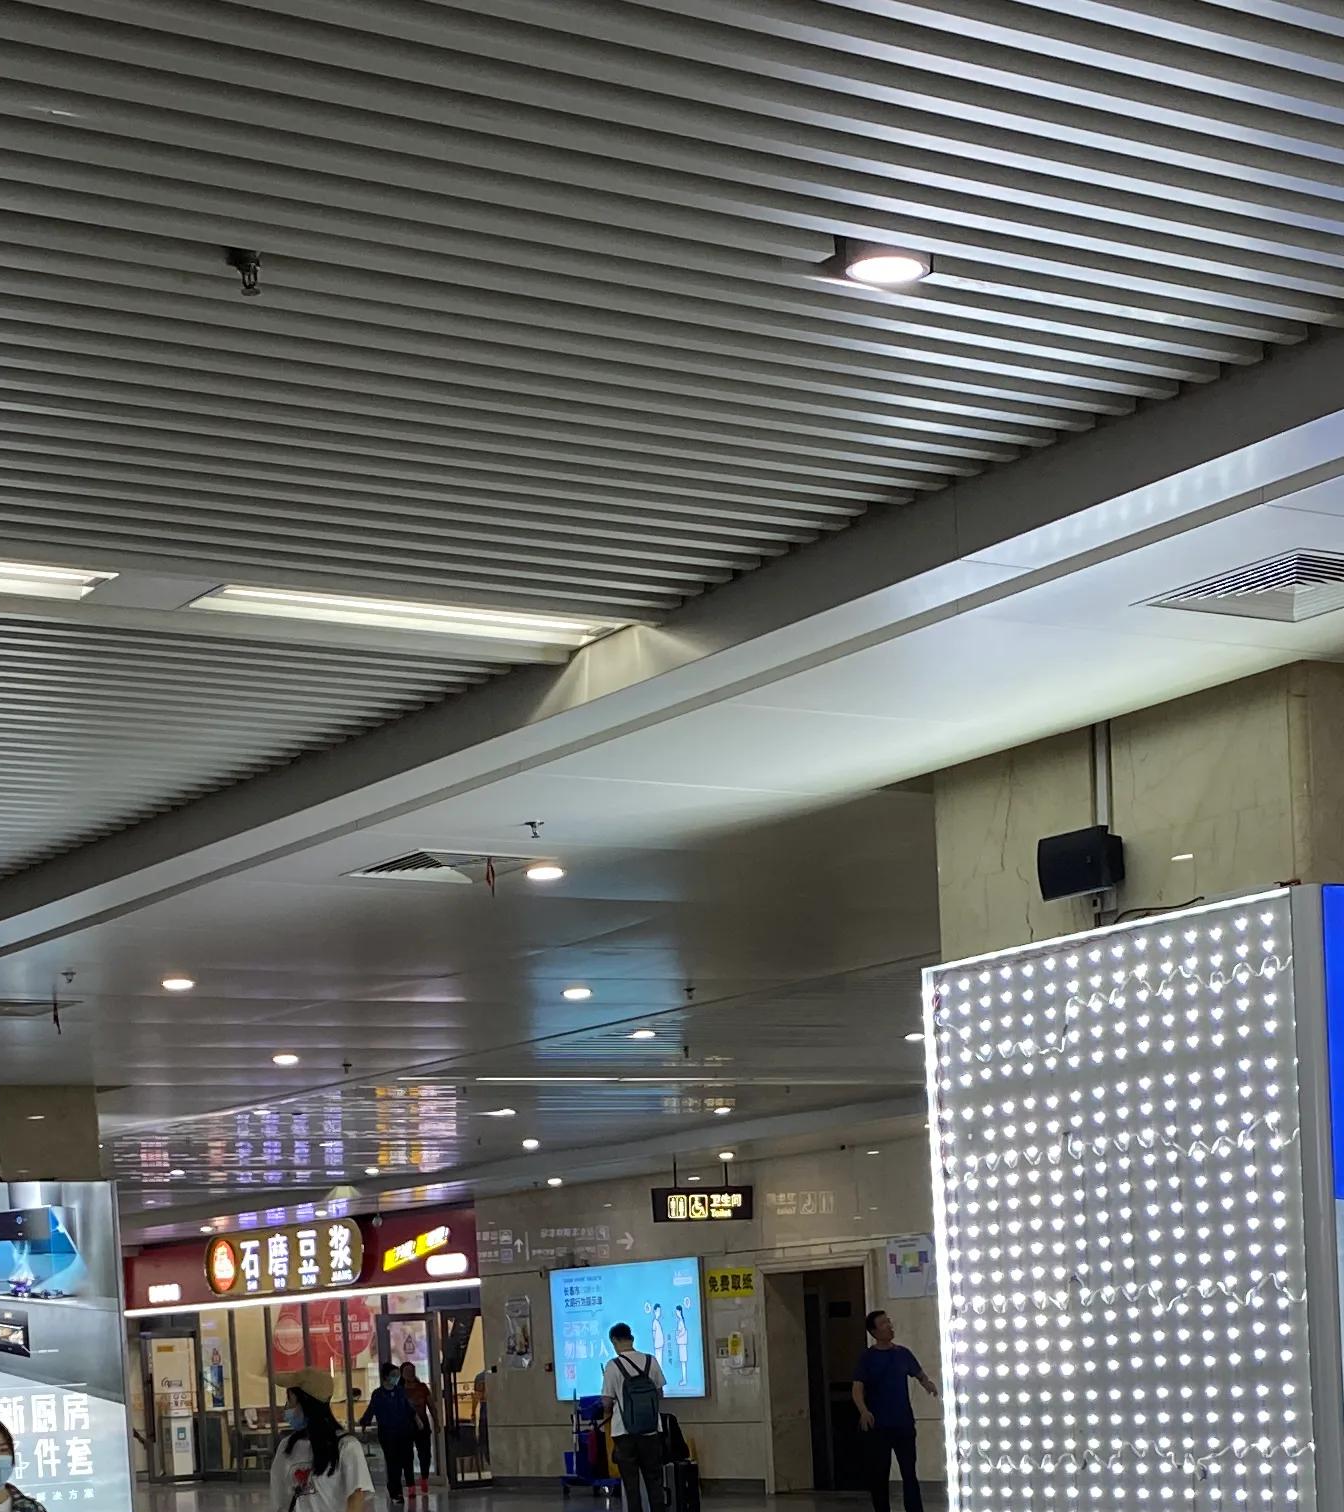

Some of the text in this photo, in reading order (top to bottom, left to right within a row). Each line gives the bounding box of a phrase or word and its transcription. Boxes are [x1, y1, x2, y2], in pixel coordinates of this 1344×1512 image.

[709, 1193, 742, 1208] 卫生间
[239, 1223, 353, 1280] 石磨豆浆
[708, 1272, 754, 1293] 免费取纸
